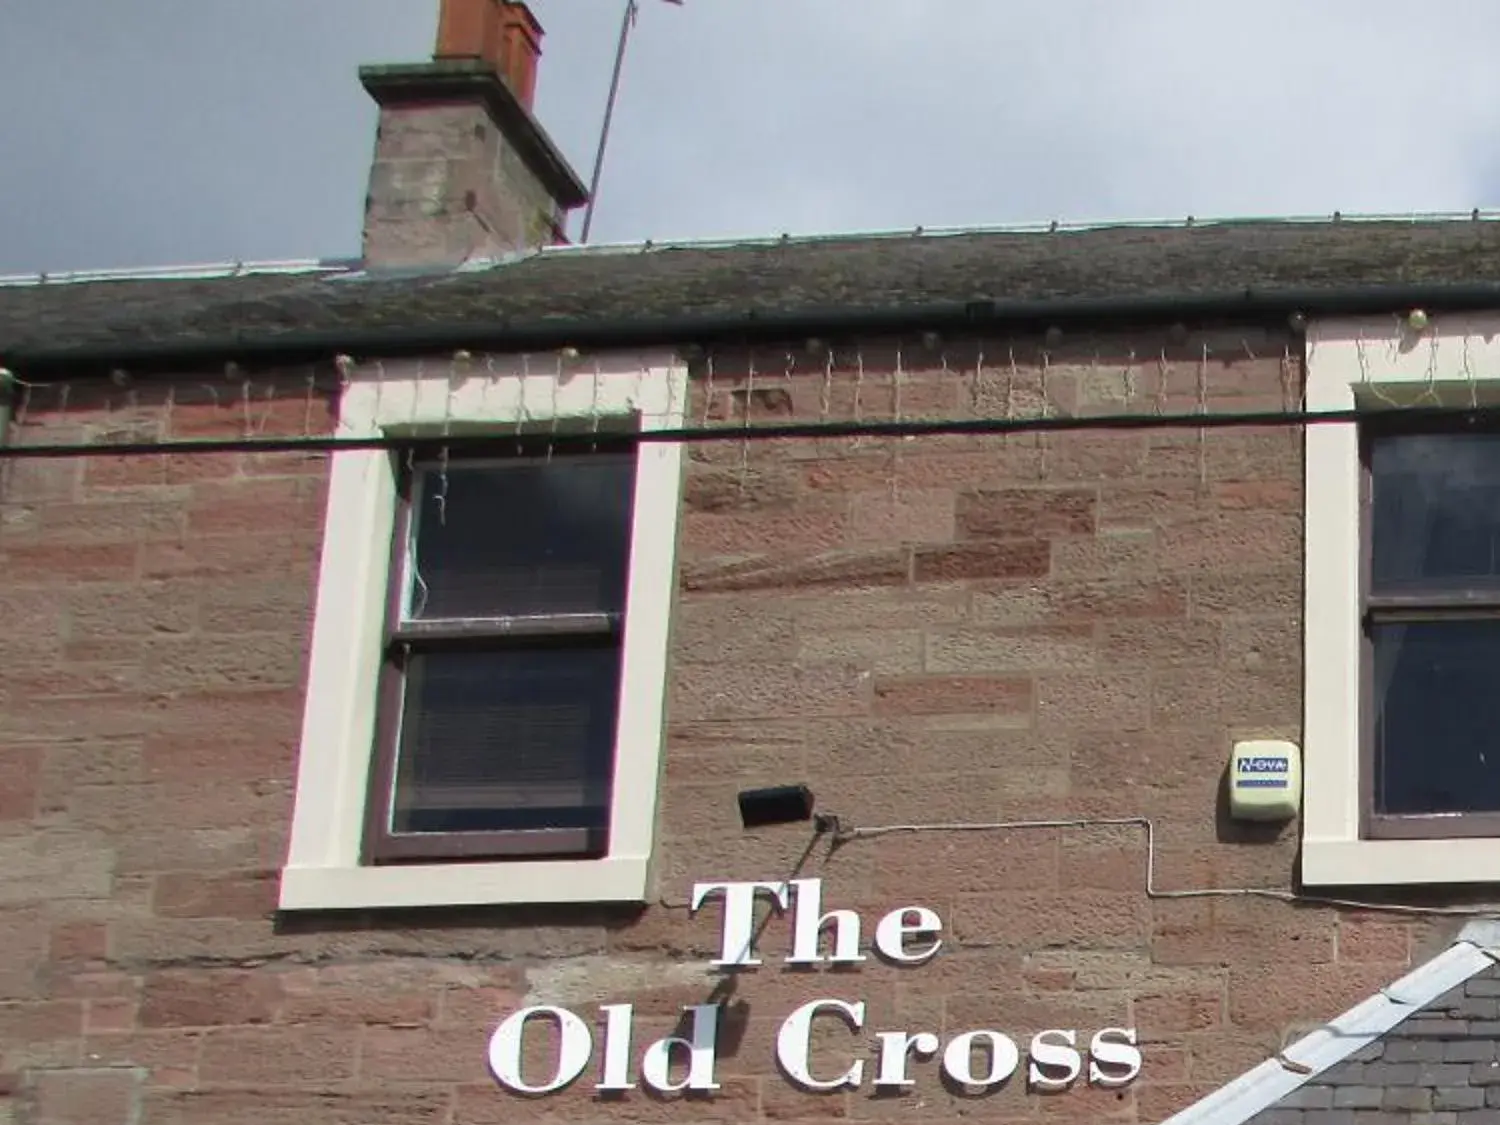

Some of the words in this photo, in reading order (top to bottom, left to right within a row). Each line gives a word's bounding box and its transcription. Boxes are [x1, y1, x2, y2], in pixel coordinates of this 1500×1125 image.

[690, 877, 943, 967] The
[489, 1003, 721, 1093] Old
[776, 998, 1143, 1091] Cross
